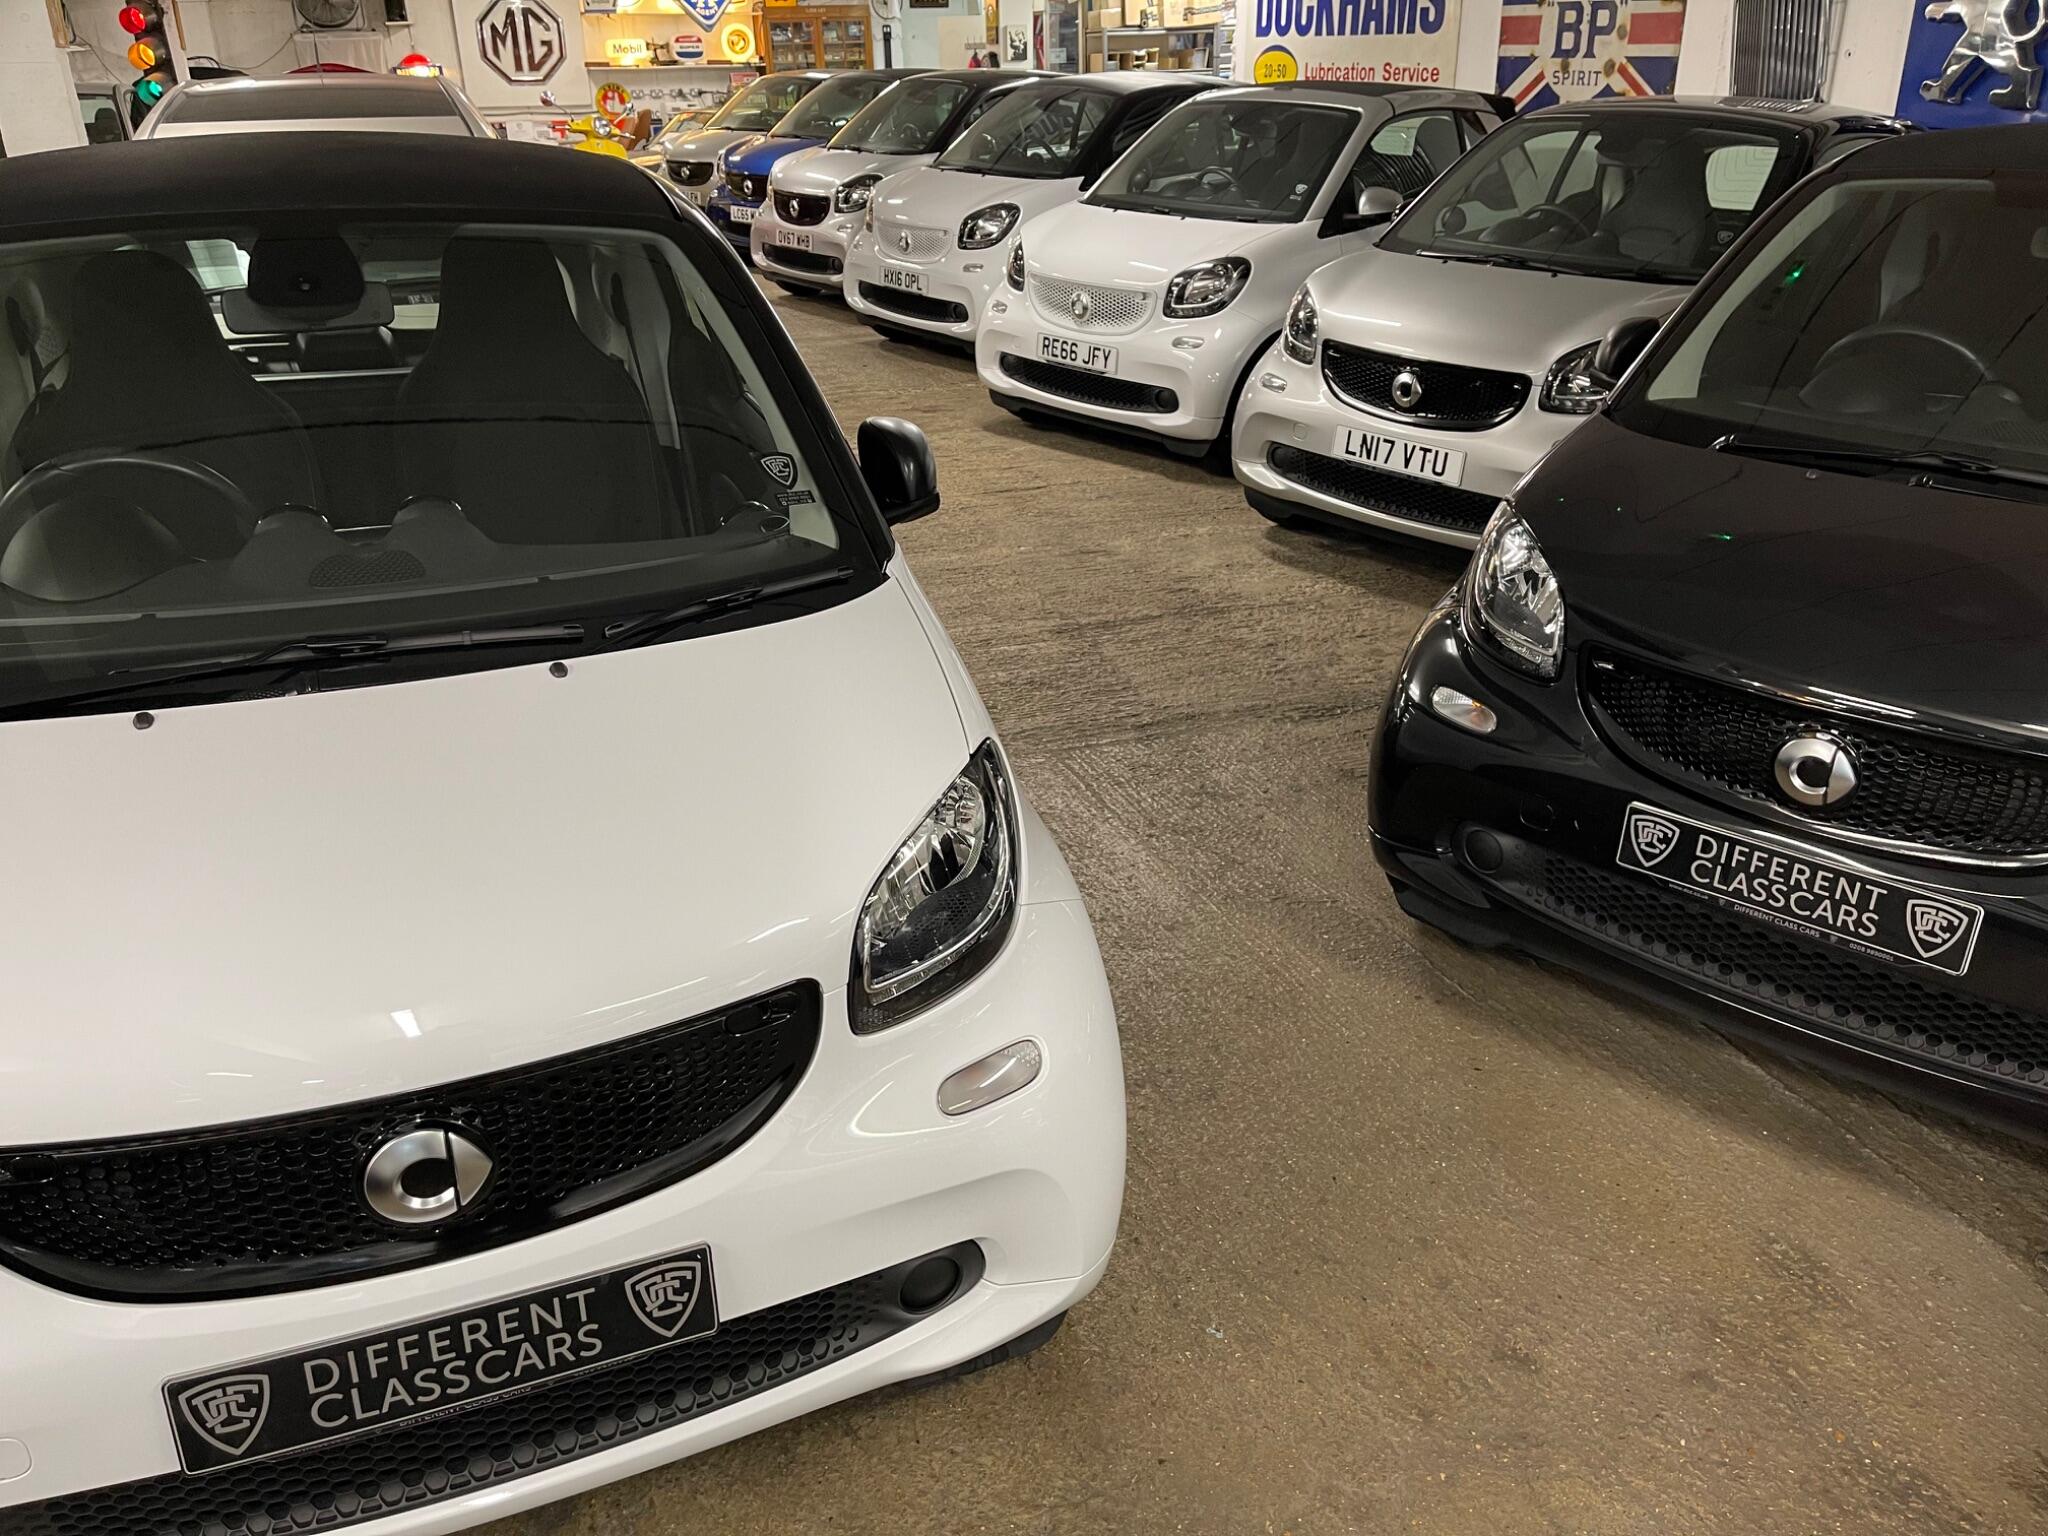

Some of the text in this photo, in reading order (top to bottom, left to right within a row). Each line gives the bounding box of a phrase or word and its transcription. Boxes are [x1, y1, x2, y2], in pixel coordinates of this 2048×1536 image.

[490, 7, 553, 72] MG
[612, 44, 642, 54] Mobil
[1264, 63, 1287, 78] 20-50
[1304, 61, 1440, 82] Lubrication Service
[1552, 70, 1602, 86] SPIRIT
[732, 208, 749, 220] LC65
[883, 269, 923, 291] HX16 OPL
[1042, 336, 1111, 369] RE66 JFY
[1345, 430, 1449, 477] LN17 VTU
[1695, 834, 1888, 911] DIFFERENT
[1690, 859, 1879, 937] CLASSCARS
[1733, 904, 1820, 938] DIFFERENT CLASS CARS
[303, 1287, 595, 1395] DIFFERENT
[310, 1323, 603, 1428] CLASSCARS
